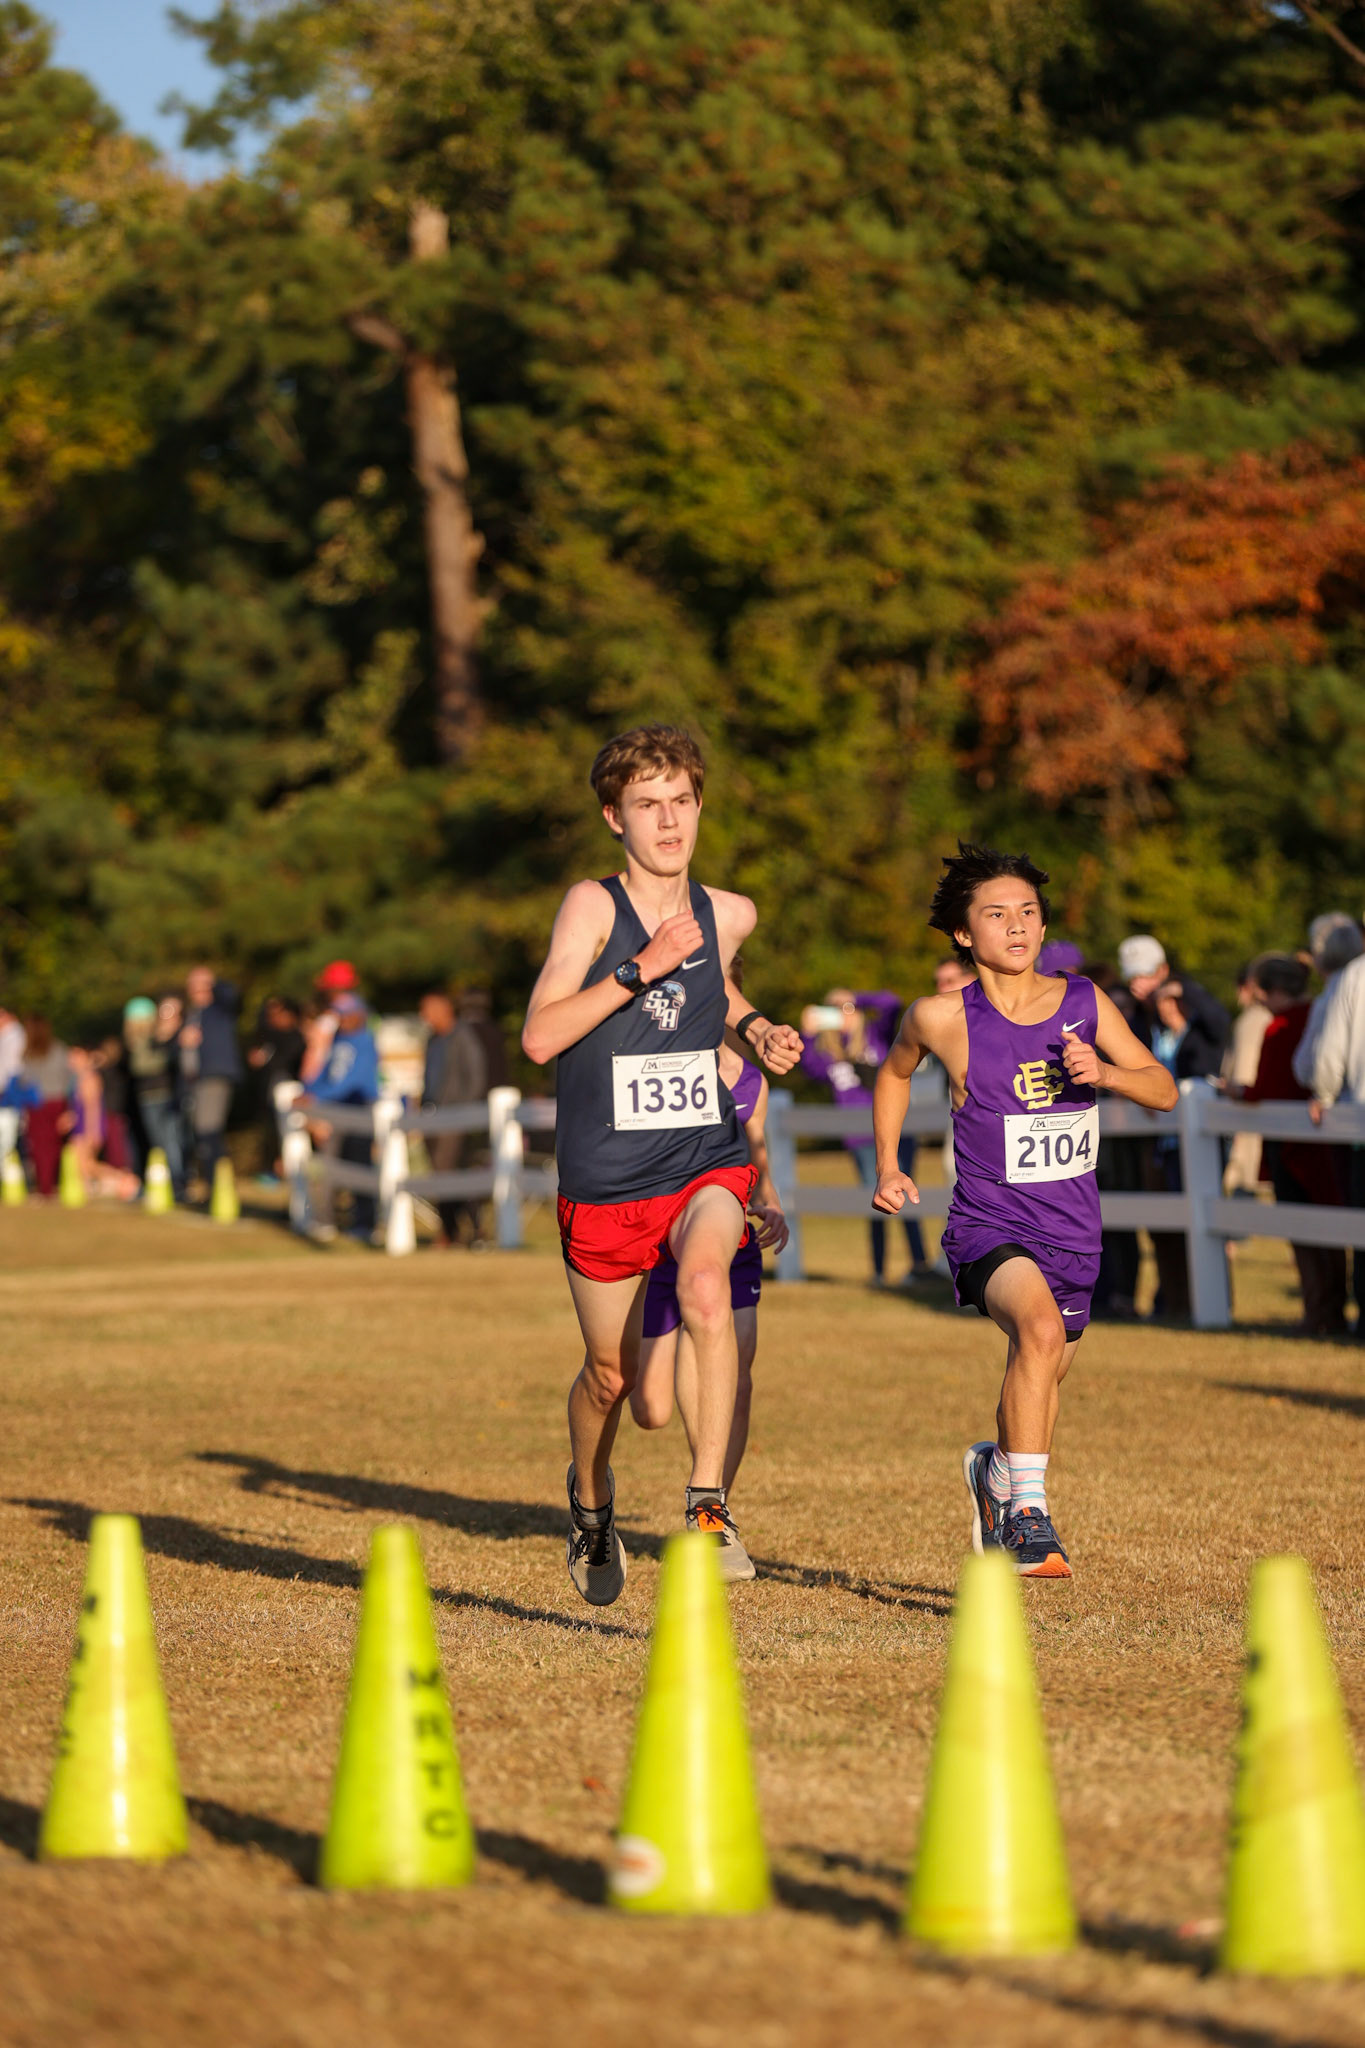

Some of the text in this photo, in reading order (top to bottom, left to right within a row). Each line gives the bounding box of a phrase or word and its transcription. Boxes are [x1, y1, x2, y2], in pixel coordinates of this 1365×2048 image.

[627, 1074, 707, 1113] 1336
[1036, 1120, 1046, 1128] M
[1017, 1129, 1091, 1168] 2104
